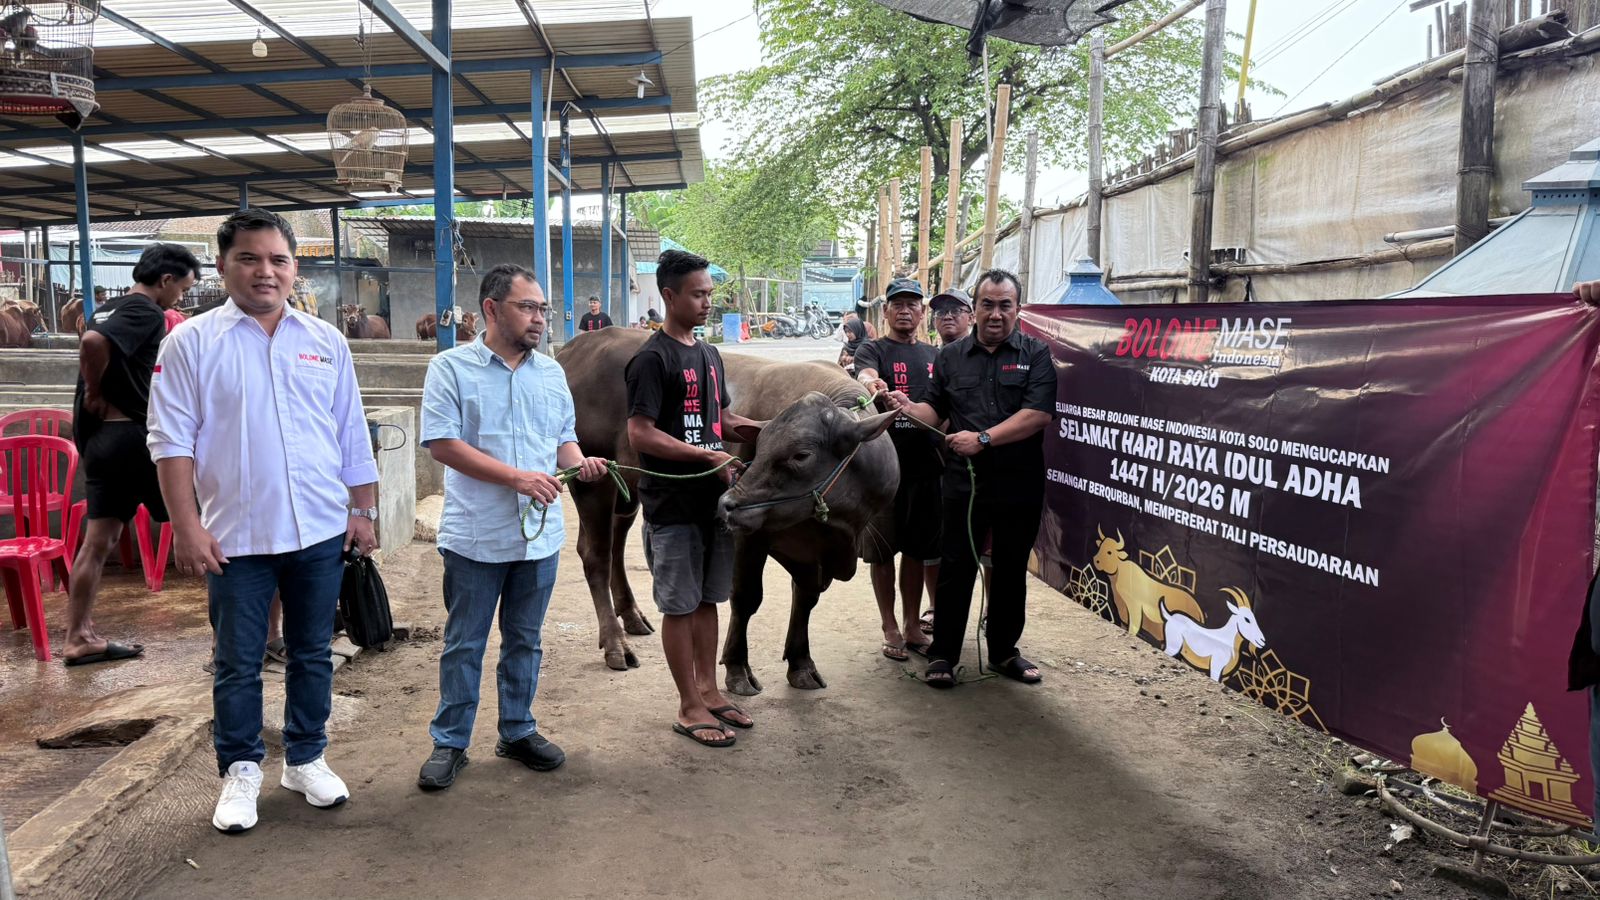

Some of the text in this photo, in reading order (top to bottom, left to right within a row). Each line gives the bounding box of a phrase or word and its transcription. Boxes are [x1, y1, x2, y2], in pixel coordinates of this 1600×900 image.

[1215, 317, 1292, 350] MASE
[1211, 349, 1280, 367] Indonesia
[683, 368, 698, 382] BO
[893, 362, 908, 373] BO
[894, 373, 908, 385] LO
[1150, 366, 1220, 389] KOTA SOLO
[686, 384, 698, 398] LO
[683, 399, 701, 413] NE
[683, 414, 704, 428] MA
[684, 429, 702, 444] SE
[1082, 406, 1106, 421] BESAR
[1107, 411, 1140, 427] BOLONE
[1140, 416, 1165, 432] MASE
[1165, 420, 1217, 442] INDONESIA
[1219, 429, 1246, 447] KOTA
[1247, 434, 1279, 454] SOLO
[1280, 440, 1390, 474] MENGUCAPKAN
[1059, 417, 1362, 509] SELAMAT HARI RAYA IDUL ADHA
[1109, 457, 1252, 519] 1447 H/2026 M
[1046, 468, 1380, 587] SEMANGAT BERQURBAN, MEMPERERAT TALI PERSAUDARAAN
